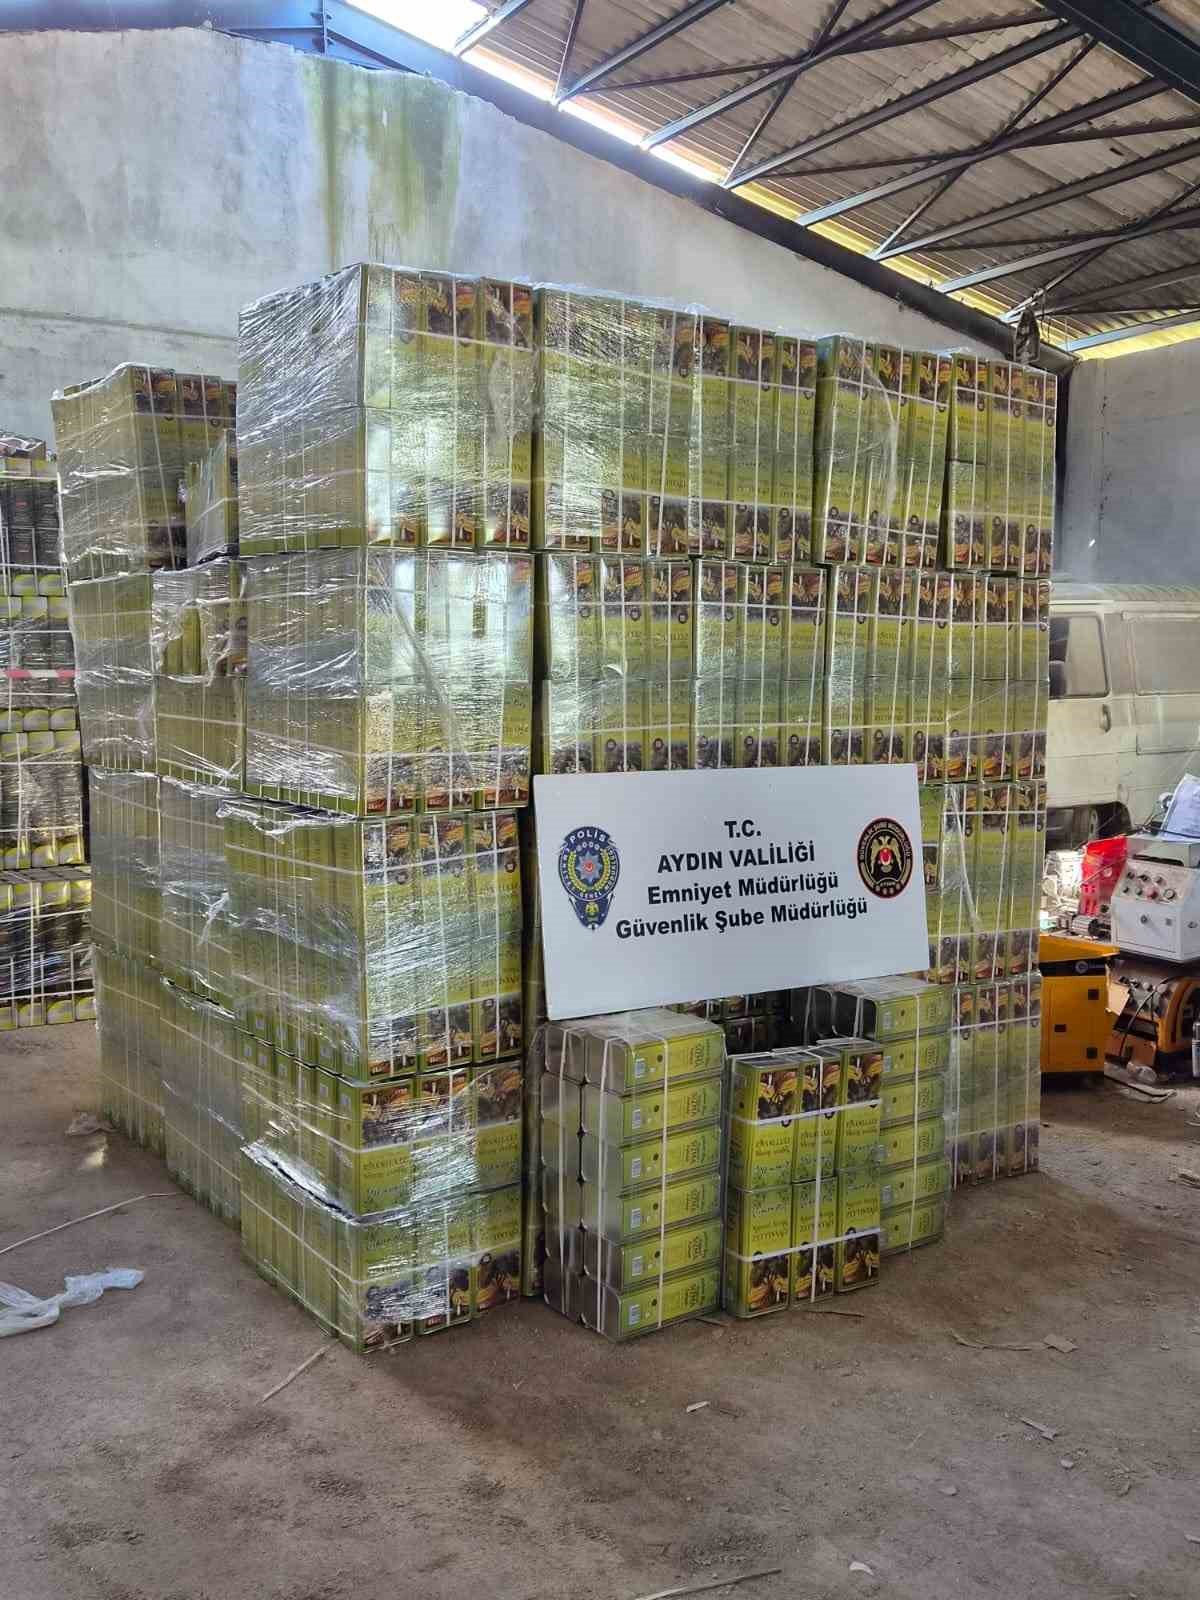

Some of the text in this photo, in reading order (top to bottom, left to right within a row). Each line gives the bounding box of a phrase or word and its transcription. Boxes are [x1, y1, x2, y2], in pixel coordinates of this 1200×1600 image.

[569, 829, 606, 843] POLİS
[724, 819, 762, 839] T.C.
[657, 839, 815, 874] AYDIN VALİLİĞİ
[648, 870, 839, 906] Emniyet Müdürlüğü
[615, 897, 869, 940] Güvenlik Şube Müdürlüğü
